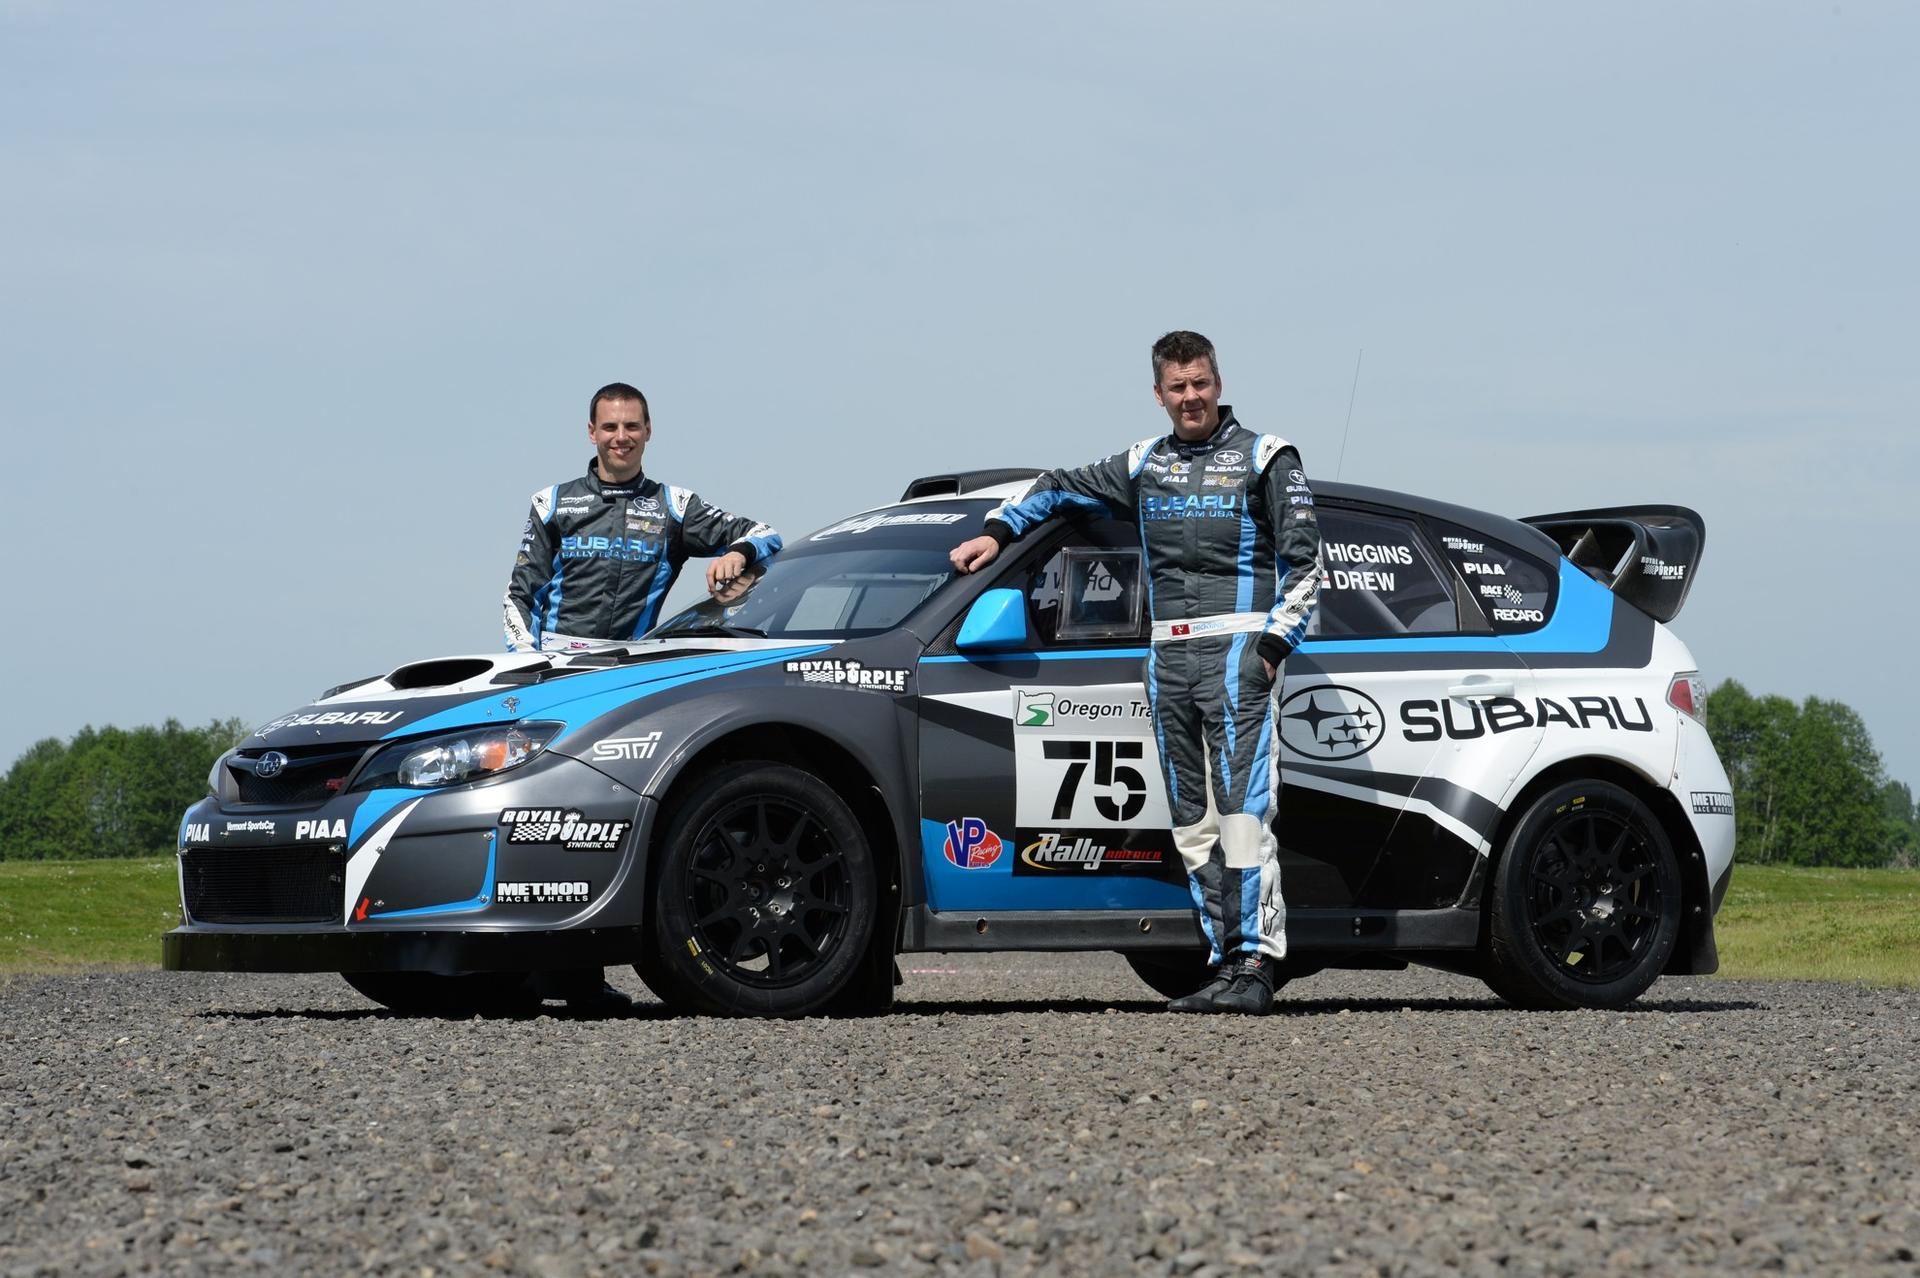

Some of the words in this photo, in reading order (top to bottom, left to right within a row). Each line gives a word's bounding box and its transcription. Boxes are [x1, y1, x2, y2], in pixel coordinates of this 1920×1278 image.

[1162, 475, 1188, 483] PIAA
[1146, 495, 1236, 511] SUBARU
[626, 508, 666, 519] SUBARU
[561, 536, 659, 555] SUBARU
[1459, 542, 1483, 551] PURPLE
[562, 551, 594, 559] RALLY
[1325, 543, 1413, 565] HIGGINS
[1463, 562, 1505, 575] PIAA
[1654, 565, 1683, 576] PURPLE
[1333, 570, 1395, 592] DREW
[1480, 585, 1503, 595] RACE
[1493, 609, 1543, 623] RECARO
[787, 661, 842, 672] ROYAL
[834, 670, 905, 685] PURPLE
[1057, 699, 1123, 720] Oregon
[1129, 702, 1152, 718] Tra
[287, 711, 405, 727] SUBARU
[1400, 696, 1654, 742] SUBARU
[1042, 740, 1147, 822] 75
[1691, 793, 1732, 807] METHOD
[501, 810, 562, 823] ROYAL
[184, 823, 210, 842] PIAA
[227, 821, 247, 831] Vermont
[247, 820, 275, 832] SportsCar
[295, 818, 347, 840] PIAA
[545, 822, 624, 842] PURPLE
[566, 841, 602, 849] SYNTHETIC
[946, 817, 987, 868] VP
[1034, 833, 1106, 870] Rally
[497, 882, 589, 896] METHOD
